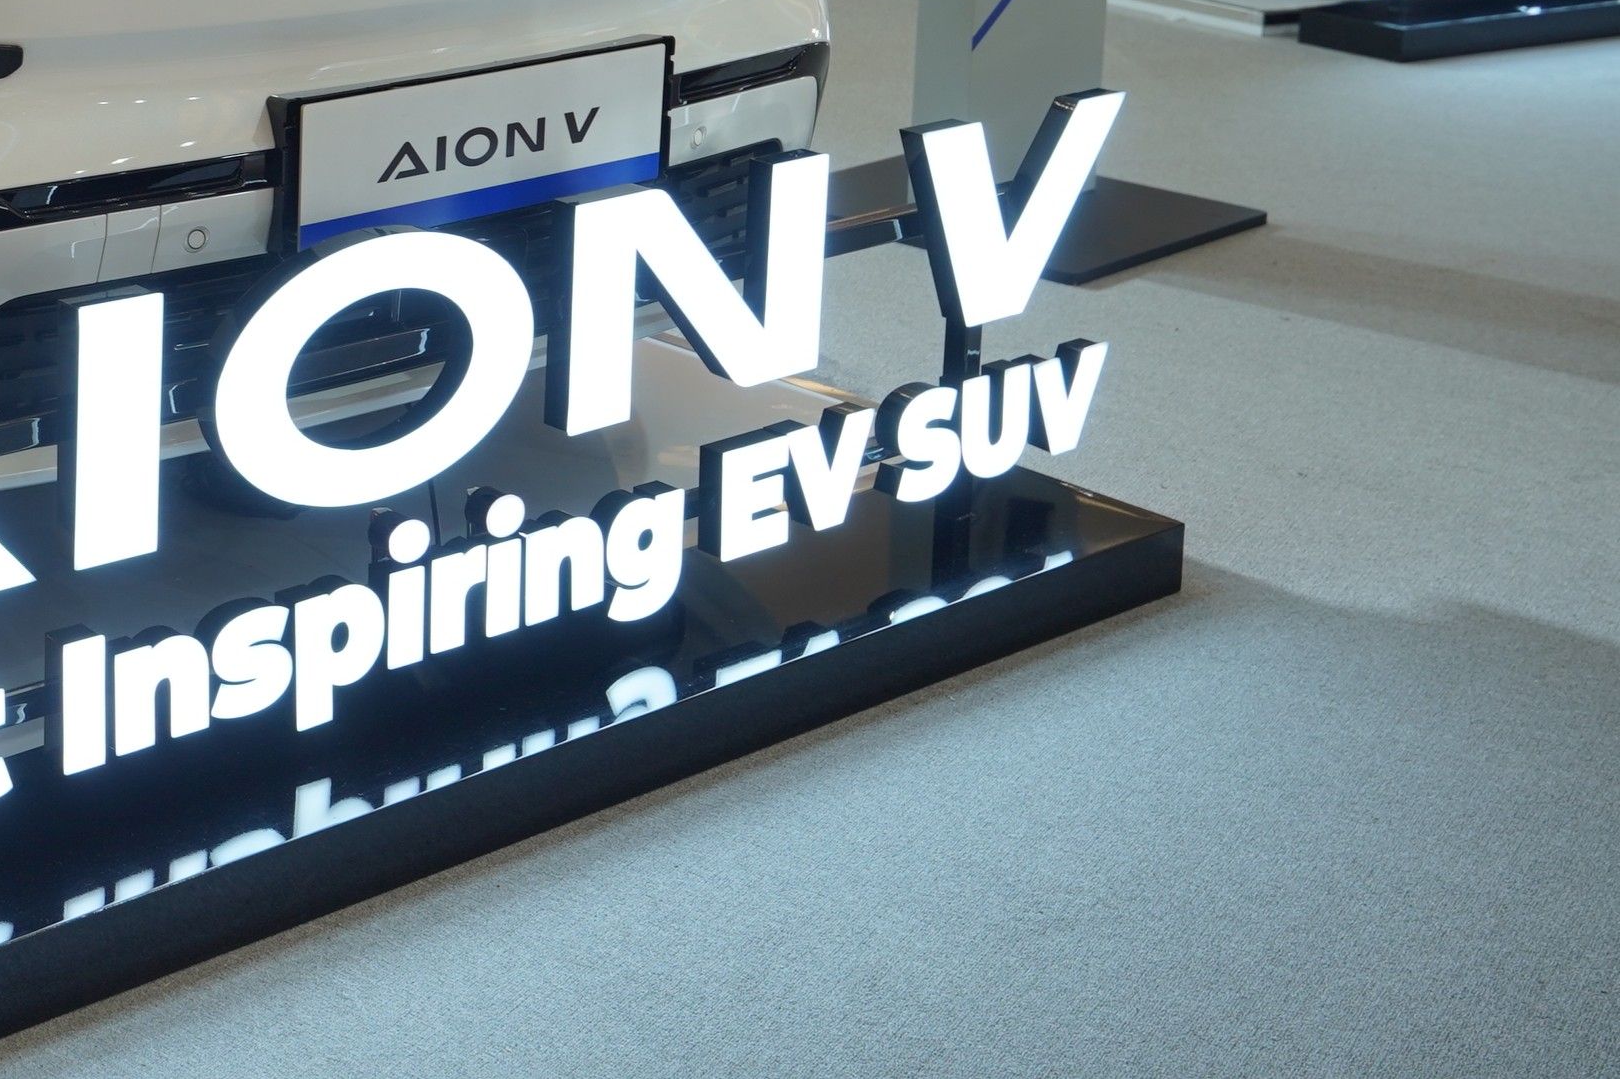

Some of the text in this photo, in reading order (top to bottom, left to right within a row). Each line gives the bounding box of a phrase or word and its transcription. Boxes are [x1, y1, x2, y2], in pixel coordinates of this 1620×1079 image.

[377, 106, 601, 183] AION V
[924, 91, 1126, 328] V
[62, 488, 685, 776] Inspiring
[720, 407, 876, 562] EV
[896, 341, 1110, 503] SUV
